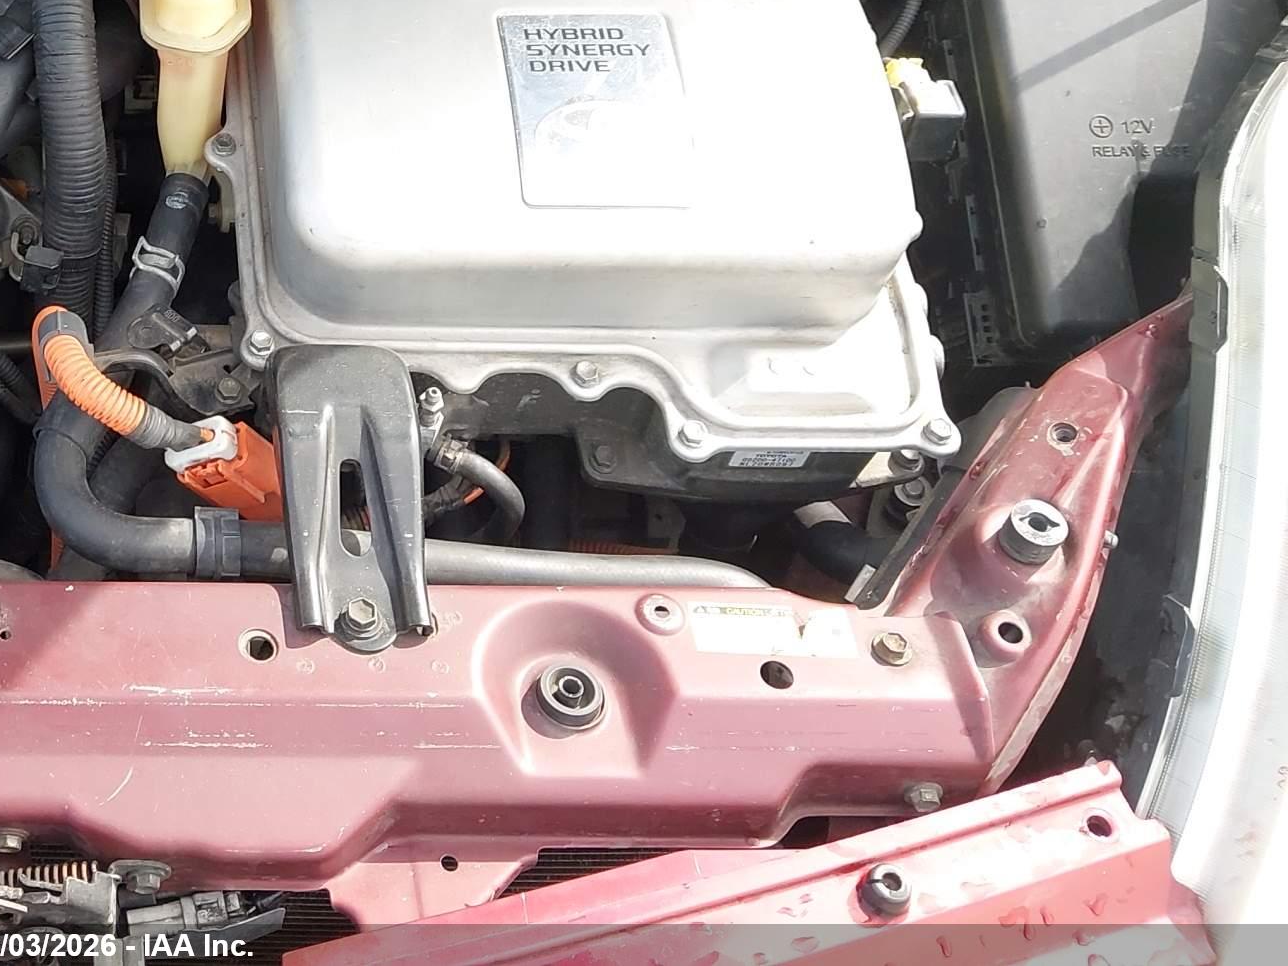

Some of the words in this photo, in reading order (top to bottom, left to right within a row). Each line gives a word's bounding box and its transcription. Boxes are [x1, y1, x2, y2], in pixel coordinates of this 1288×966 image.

[524, 28, 624, 40] HYBRID
[526, 44, 650, 56] SYNERGY
[529, 60, 611, 72] DRIVE
[1121, 119, 1153, 134] 12V
[1092, 146, 1135, 157] RELAY
